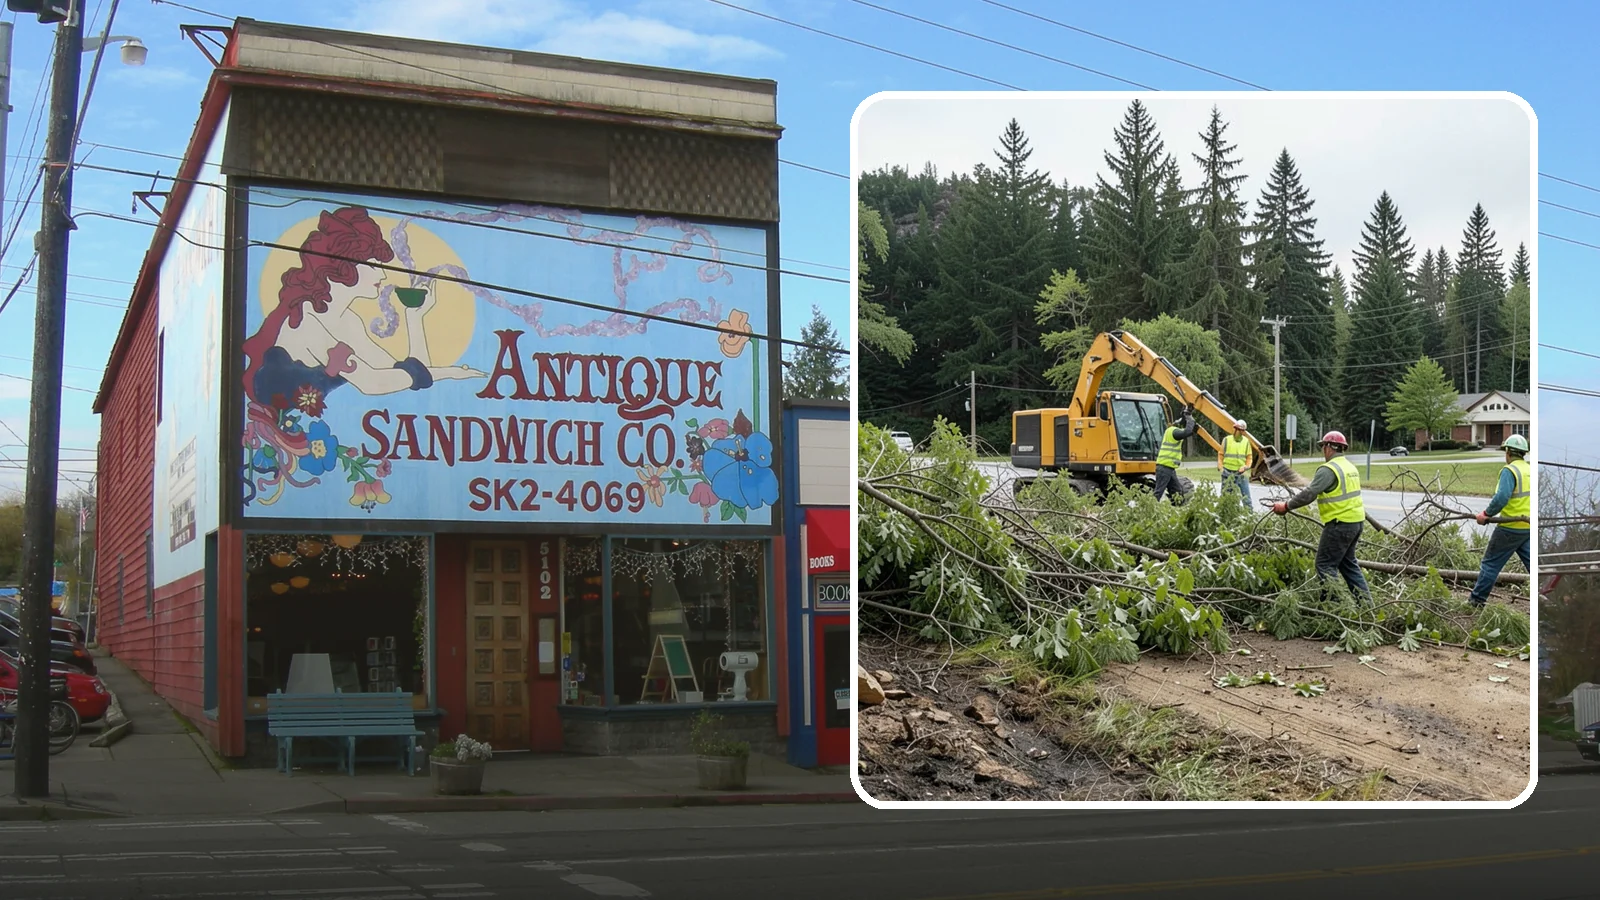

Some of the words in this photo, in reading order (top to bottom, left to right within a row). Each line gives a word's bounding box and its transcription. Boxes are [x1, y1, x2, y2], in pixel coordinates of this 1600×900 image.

[476, 329, 723, 420] ANTIQUE
[361, 409, 605, 467] SANDWICH
[617, 421, 686, 469] CO.
[468, 477, 646, 512] SK2-4069
[540, 542, 551, 599] 5102
[809, 555, 835, 568] BOOKS
